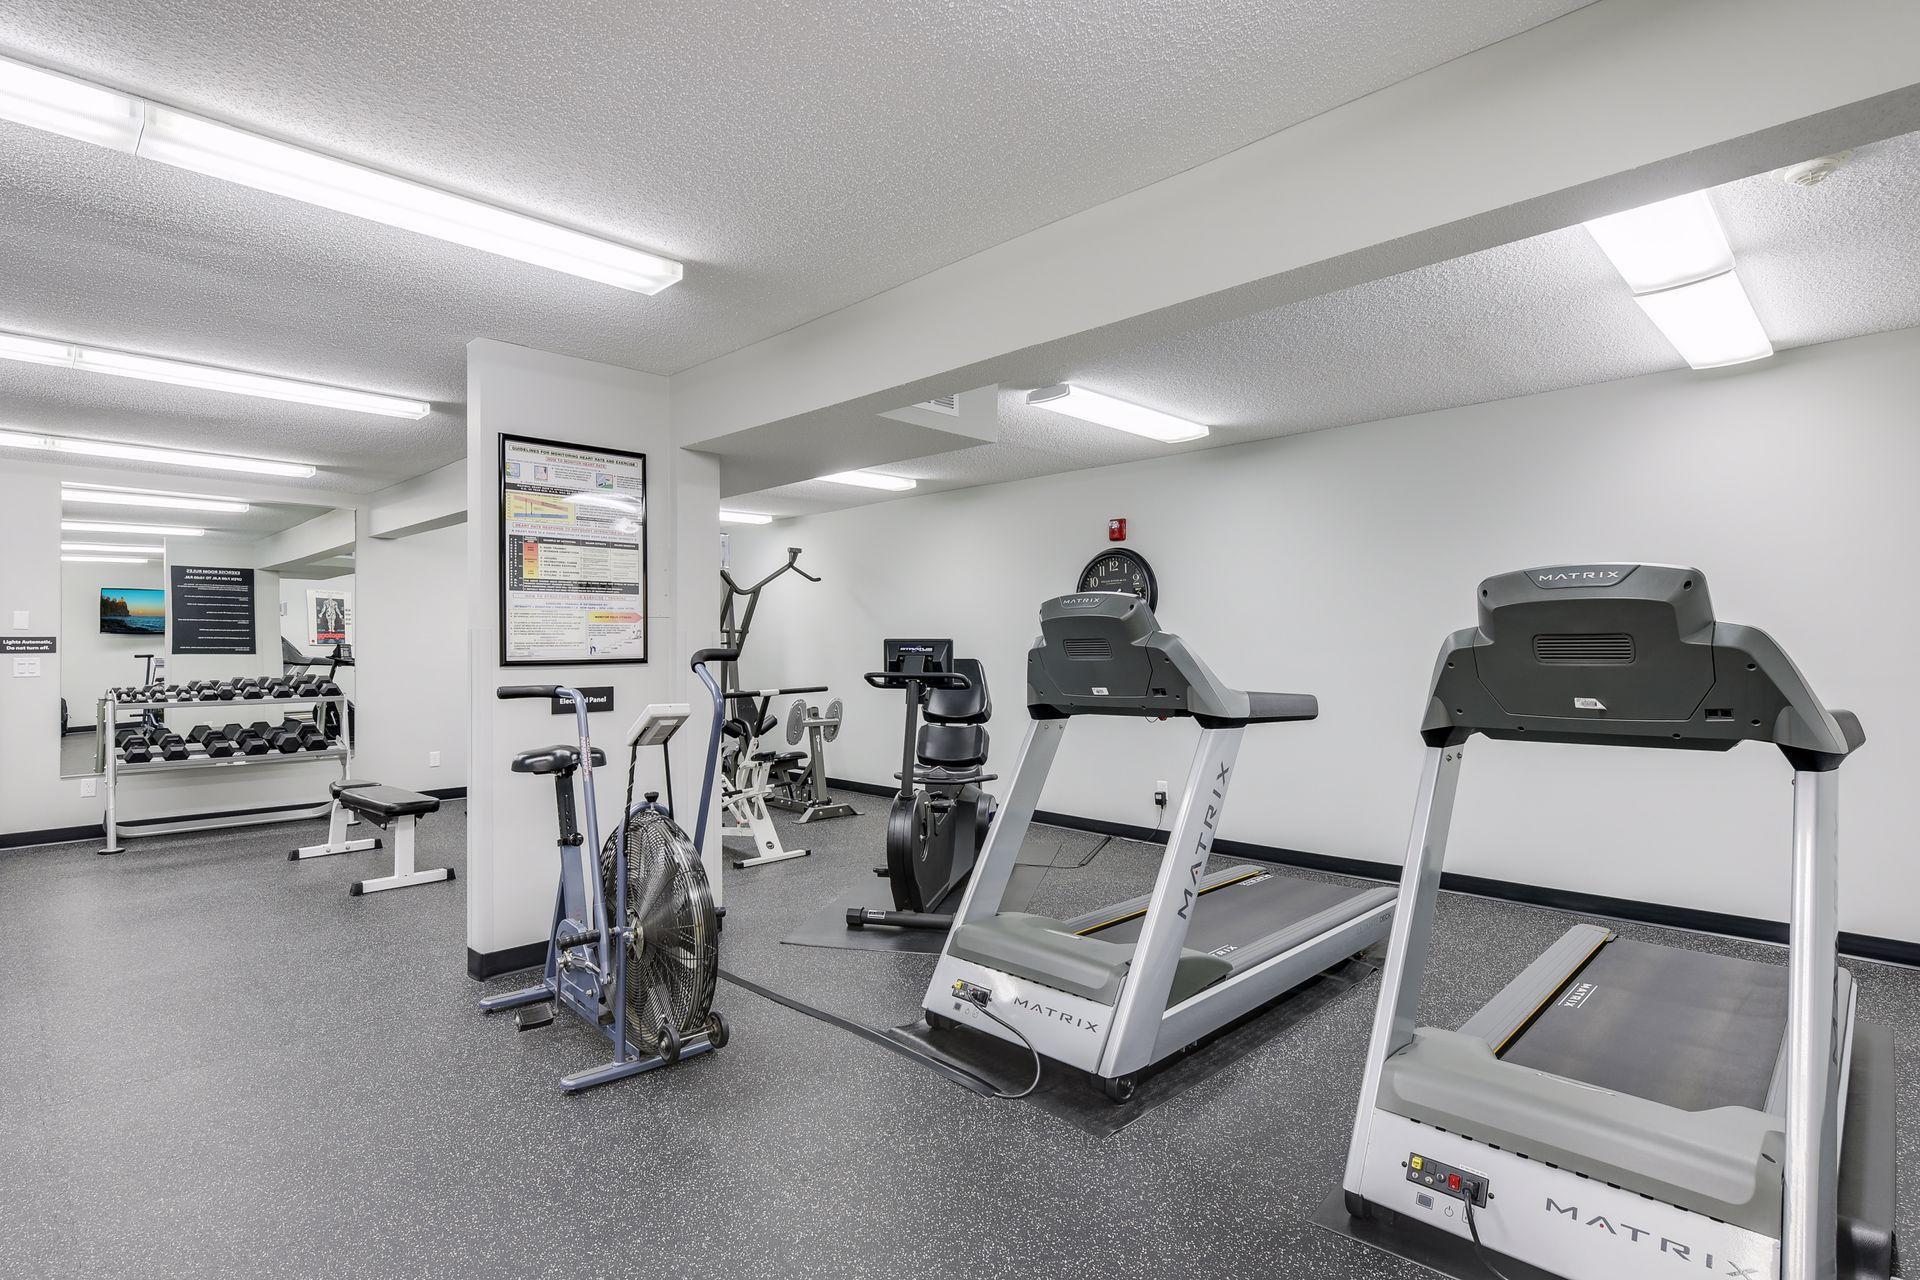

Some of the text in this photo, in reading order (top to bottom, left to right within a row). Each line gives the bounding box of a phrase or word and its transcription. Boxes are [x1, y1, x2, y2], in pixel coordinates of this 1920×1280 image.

[550, 451, 578, 459] MONITORING
[1099, 566, 1105, 576] 11
[1109, 560, 1119, 571] 12
[1124, 563, 1127, 574] 1
[1132, 573, 1140, 586] 2
[1538, 570, 1619, 582] MATRIX
[1089, 577, 1098, 588] 10
[559, 696, 588, 705] Electal
[1177, 761, 1230, 920] MATRIX
[1563, 983, 1593, 1008] MATRIX
[1013, 996, 1099, 1033] MATRIX
[1545, 1197, 1758, 1280] MATRIX
